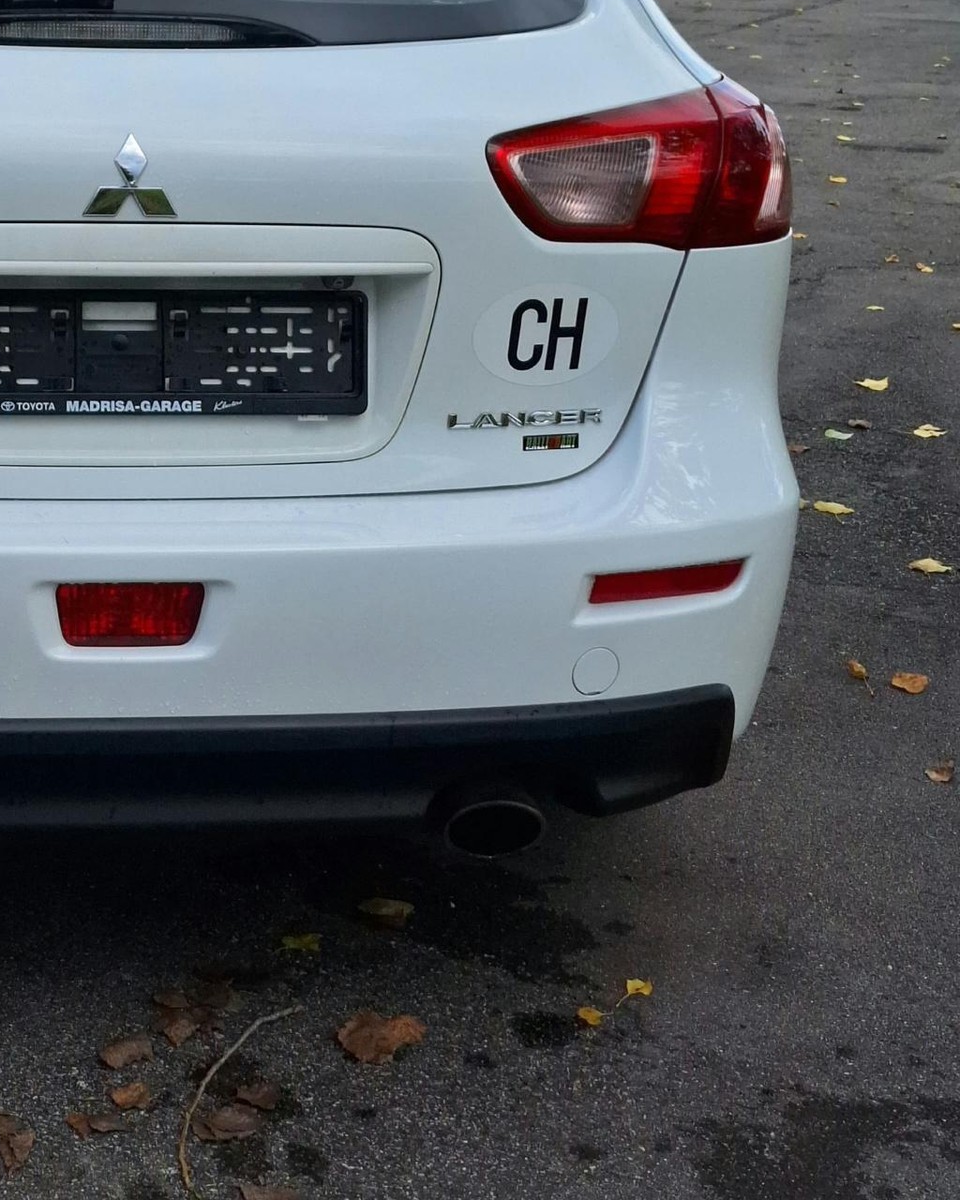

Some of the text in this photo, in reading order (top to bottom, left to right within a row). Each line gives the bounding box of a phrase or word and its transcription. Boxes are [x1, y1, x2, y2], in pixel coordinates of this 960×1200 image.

[507, 297, 589, 371] CH
[16, 402, 56, 411] TOYOTA
[66, 400, 202, 412] MADRISA-GARAGE
[447, 408, 602, 430] LANCER
